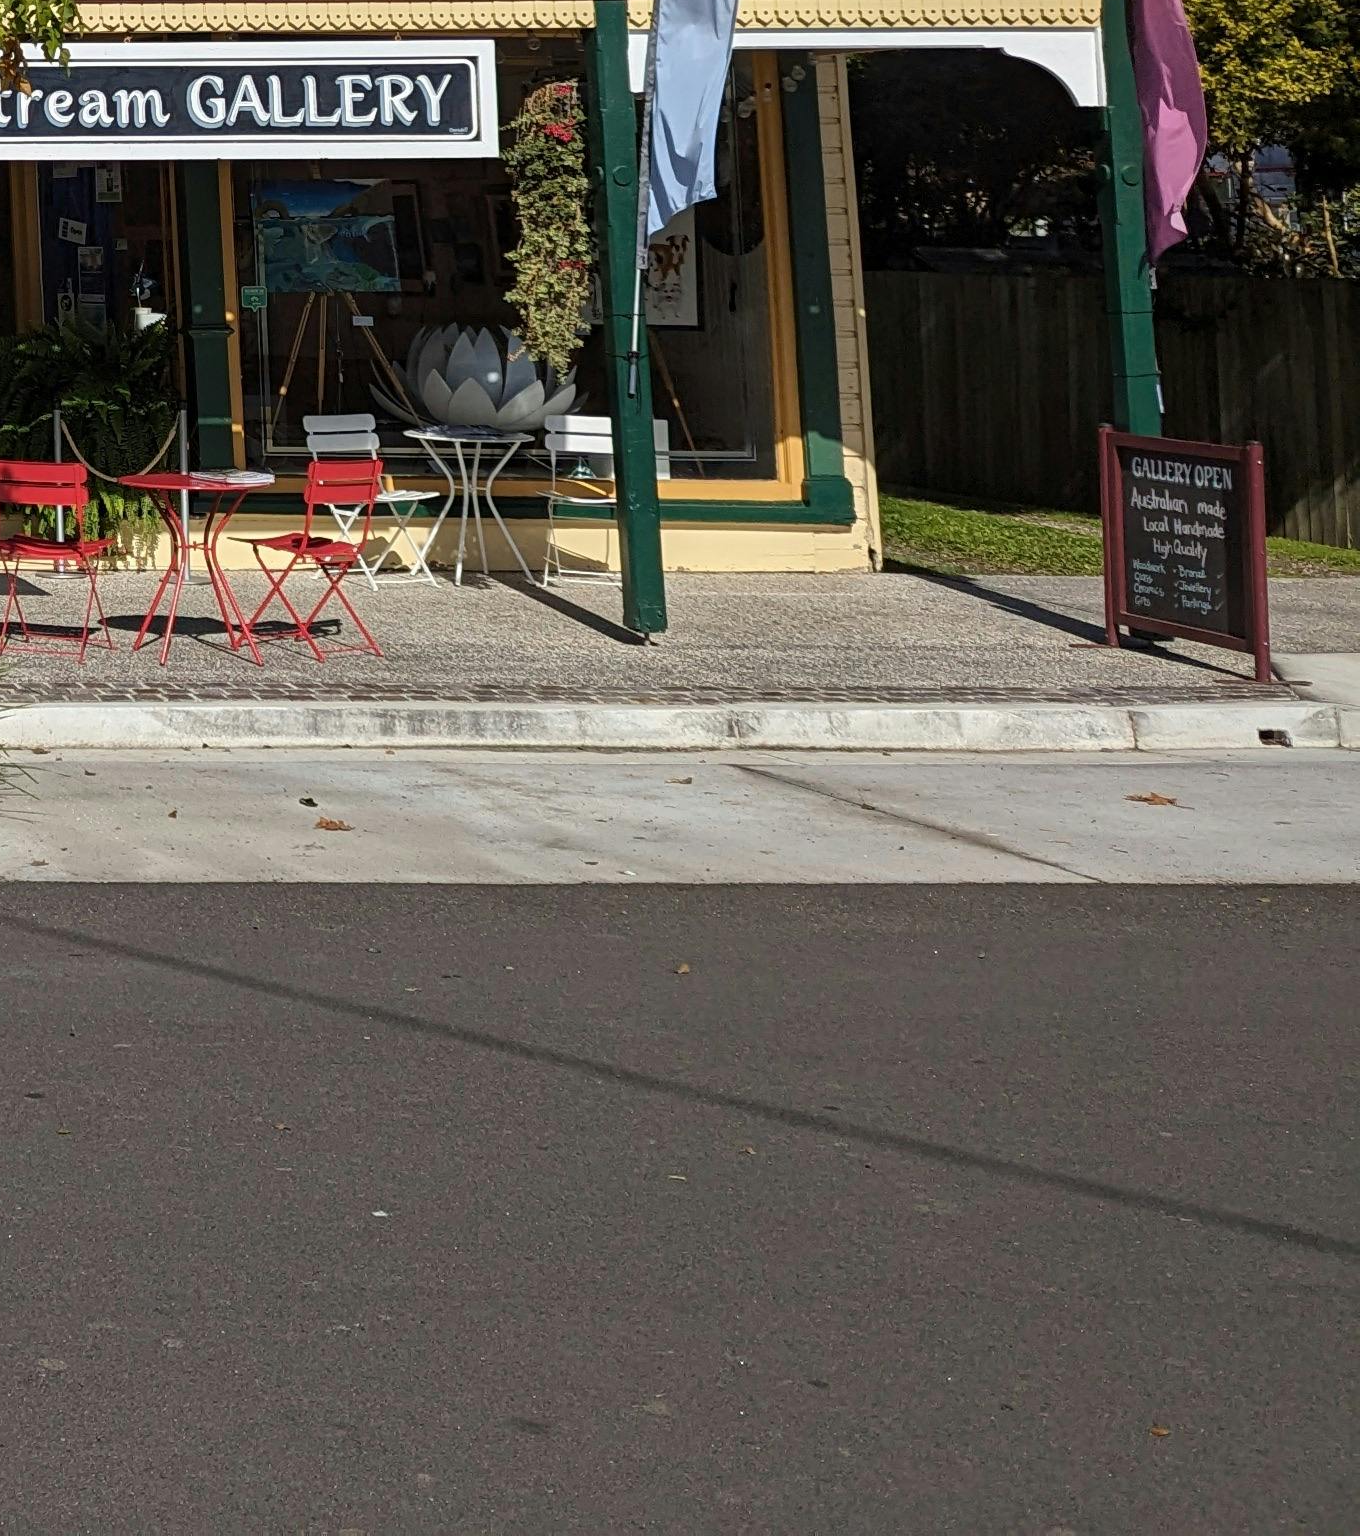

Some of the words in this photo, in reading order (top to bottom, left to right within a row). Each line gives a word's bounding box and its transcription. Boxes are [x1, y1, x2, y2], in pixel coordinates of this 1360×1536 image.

[187, 73, 453, 129] GALLERY
[1131, 456, 1193, 485] GALLERY
[1194, 464, 1233, 490] OPEN
[1130, 486, 1189, 514] Australian
[1196, 499, 1227, 520] made
[1143, 515, 1170, 532] Local
